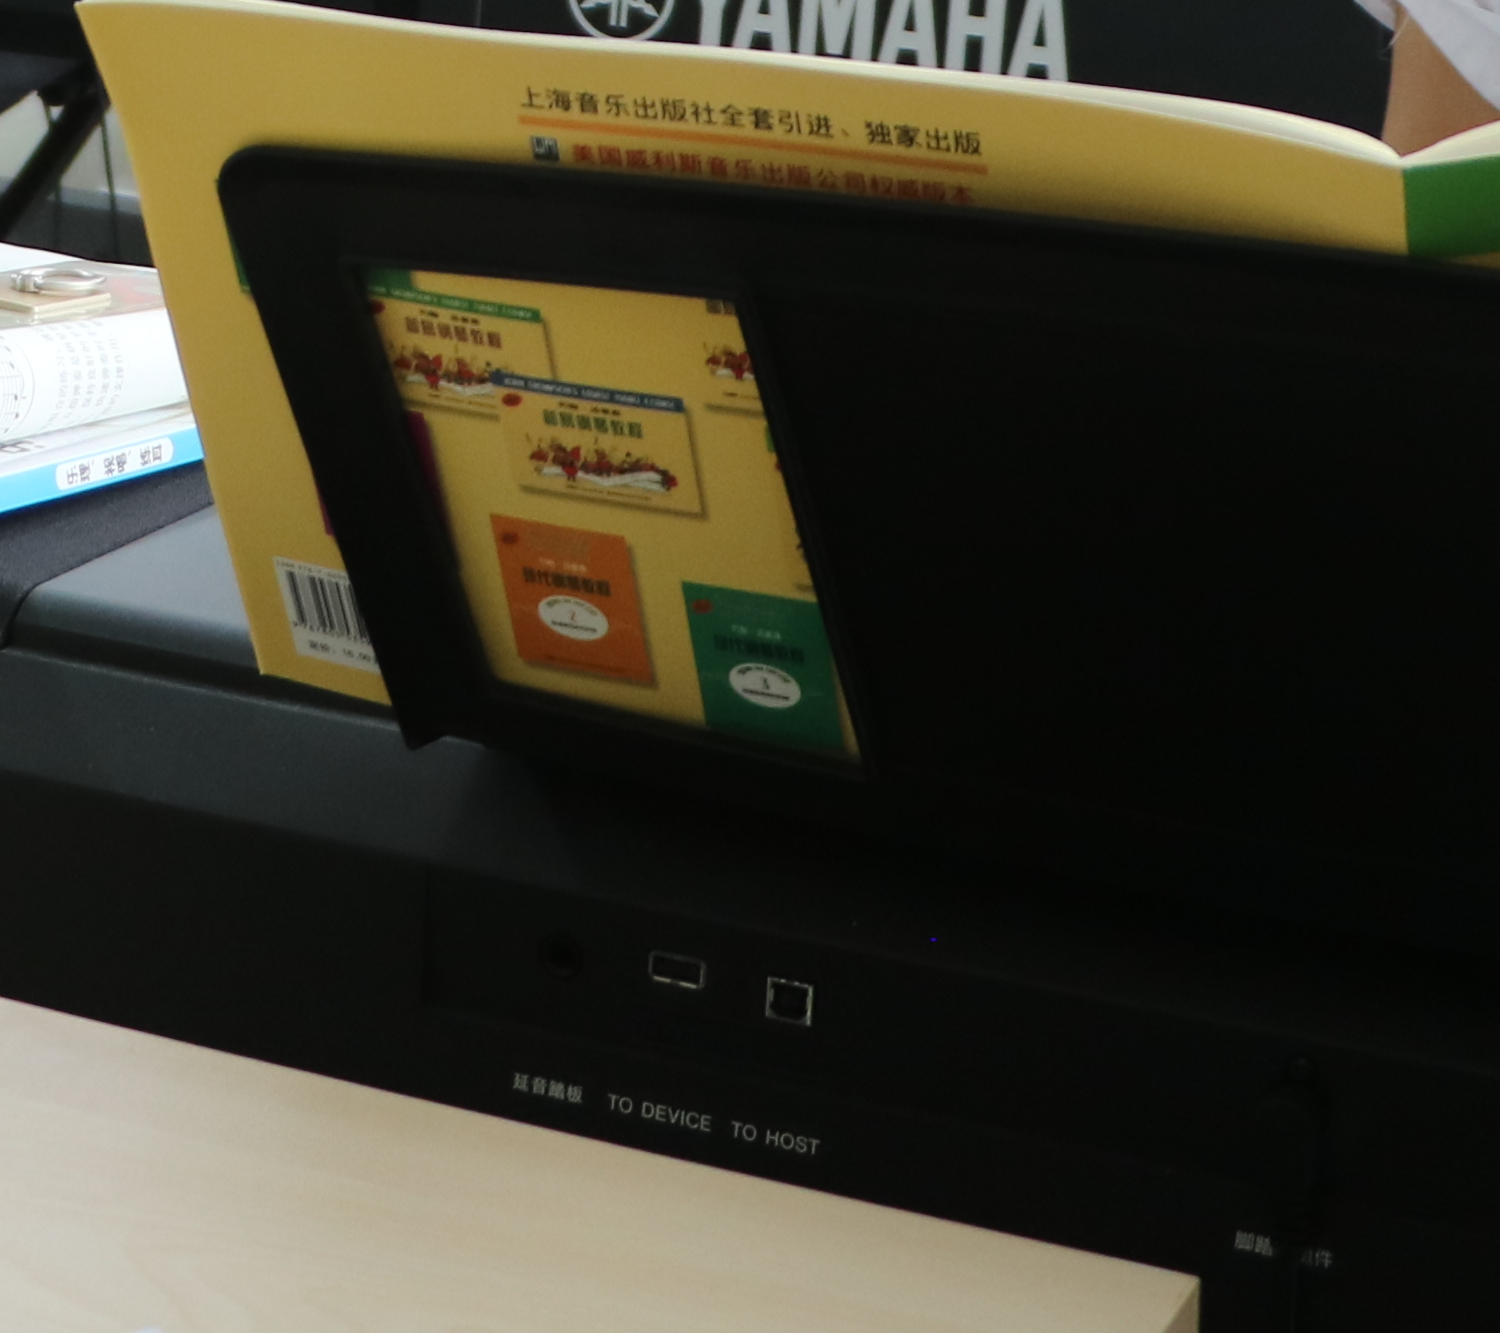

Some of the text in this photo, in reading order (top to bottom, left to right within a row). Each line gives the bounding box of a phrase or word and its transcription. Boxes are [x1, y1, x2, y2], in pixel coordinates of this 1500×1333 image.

[520, 85, 982, 156] 上海音乐出版社全套引进、独家出版
[513, 1072, 583, 1104] 延音踏板
[608, 1093, 713, 1132] TO DEVICE
[731, 1121, 821, 1156] TO HOST
